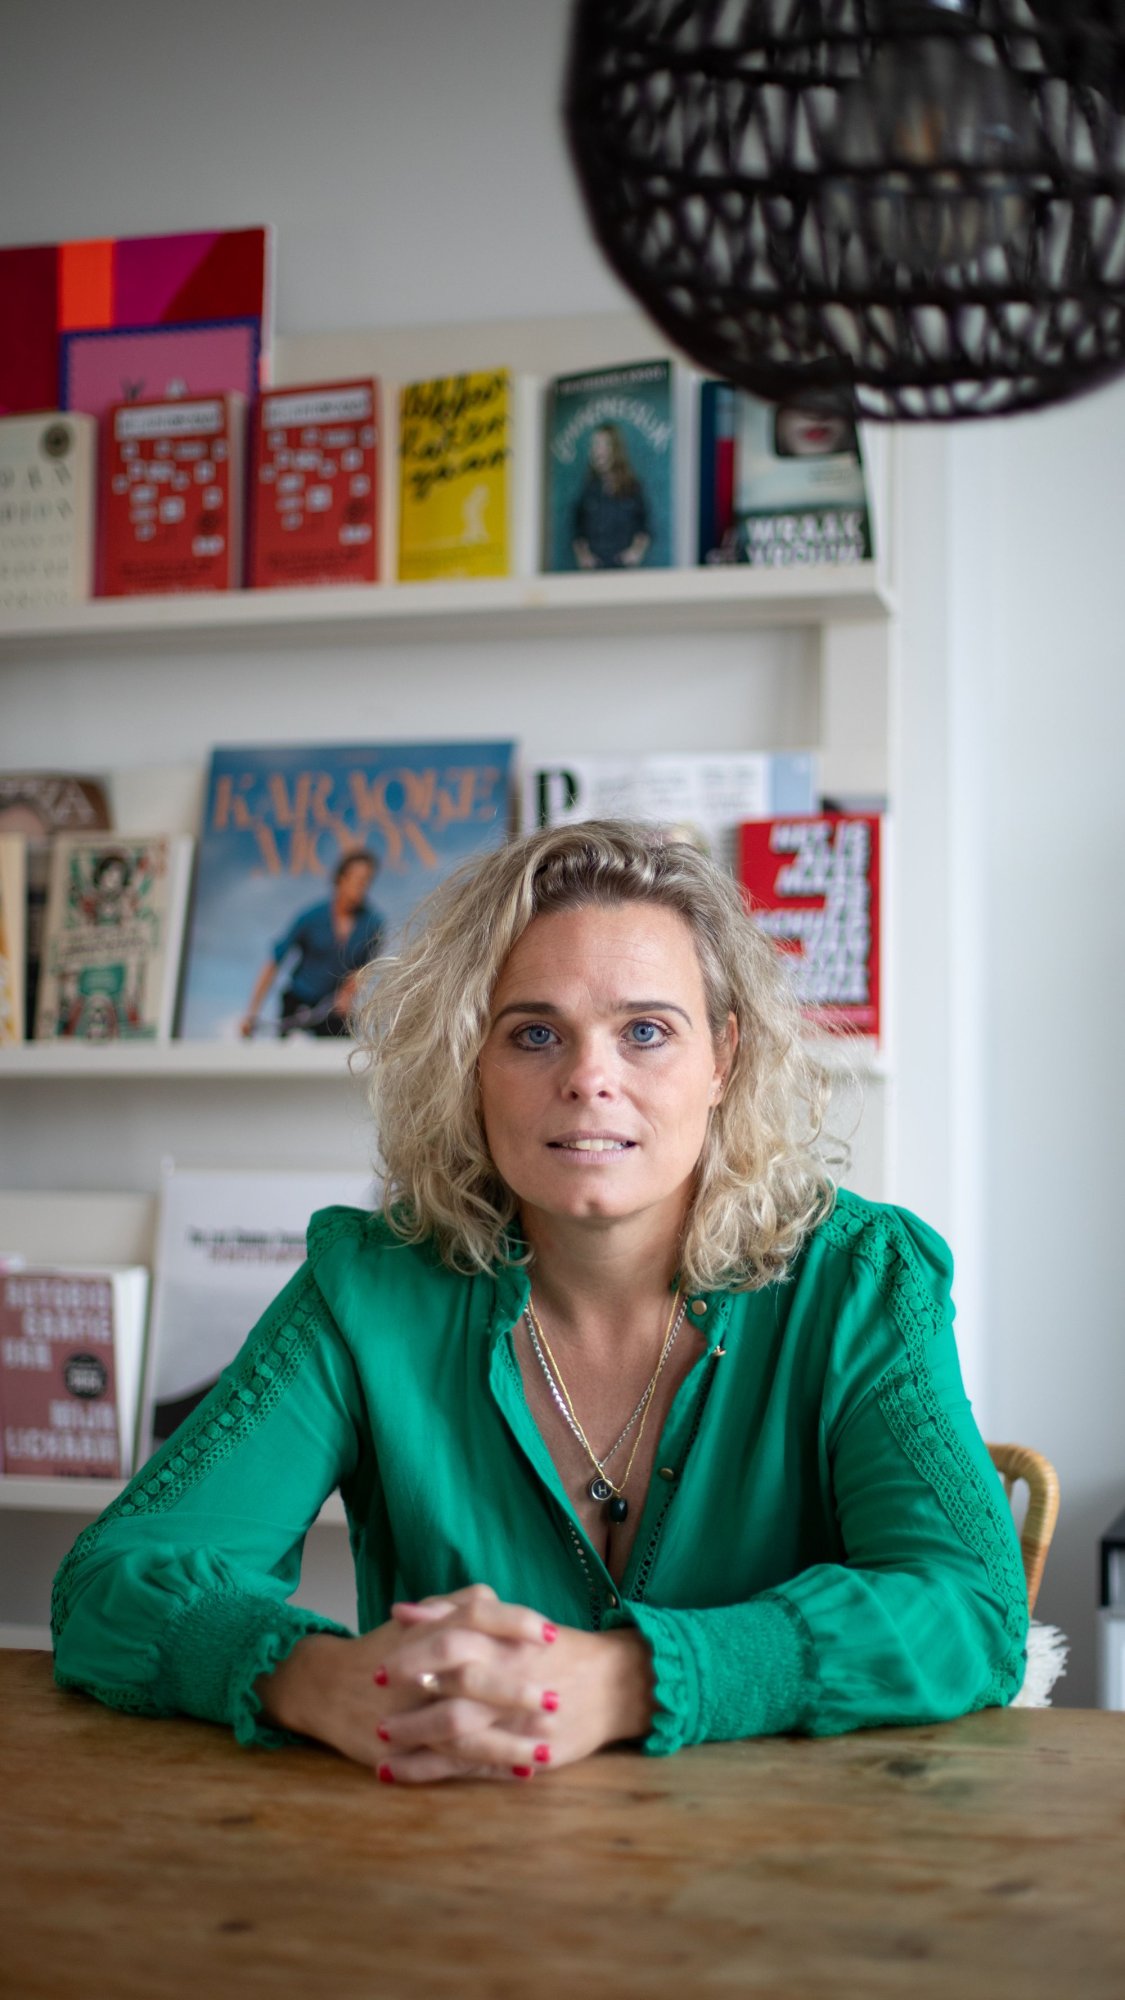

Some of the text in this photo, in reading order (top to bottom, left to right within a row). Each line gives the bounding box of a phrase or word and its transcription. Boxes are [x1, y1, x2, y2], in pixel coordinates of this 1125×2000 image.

[747, 511, 865, 544] WRAAK
[213, 766, 500, 831] KARAOKE
[250, 818, 439, 878] MOON
